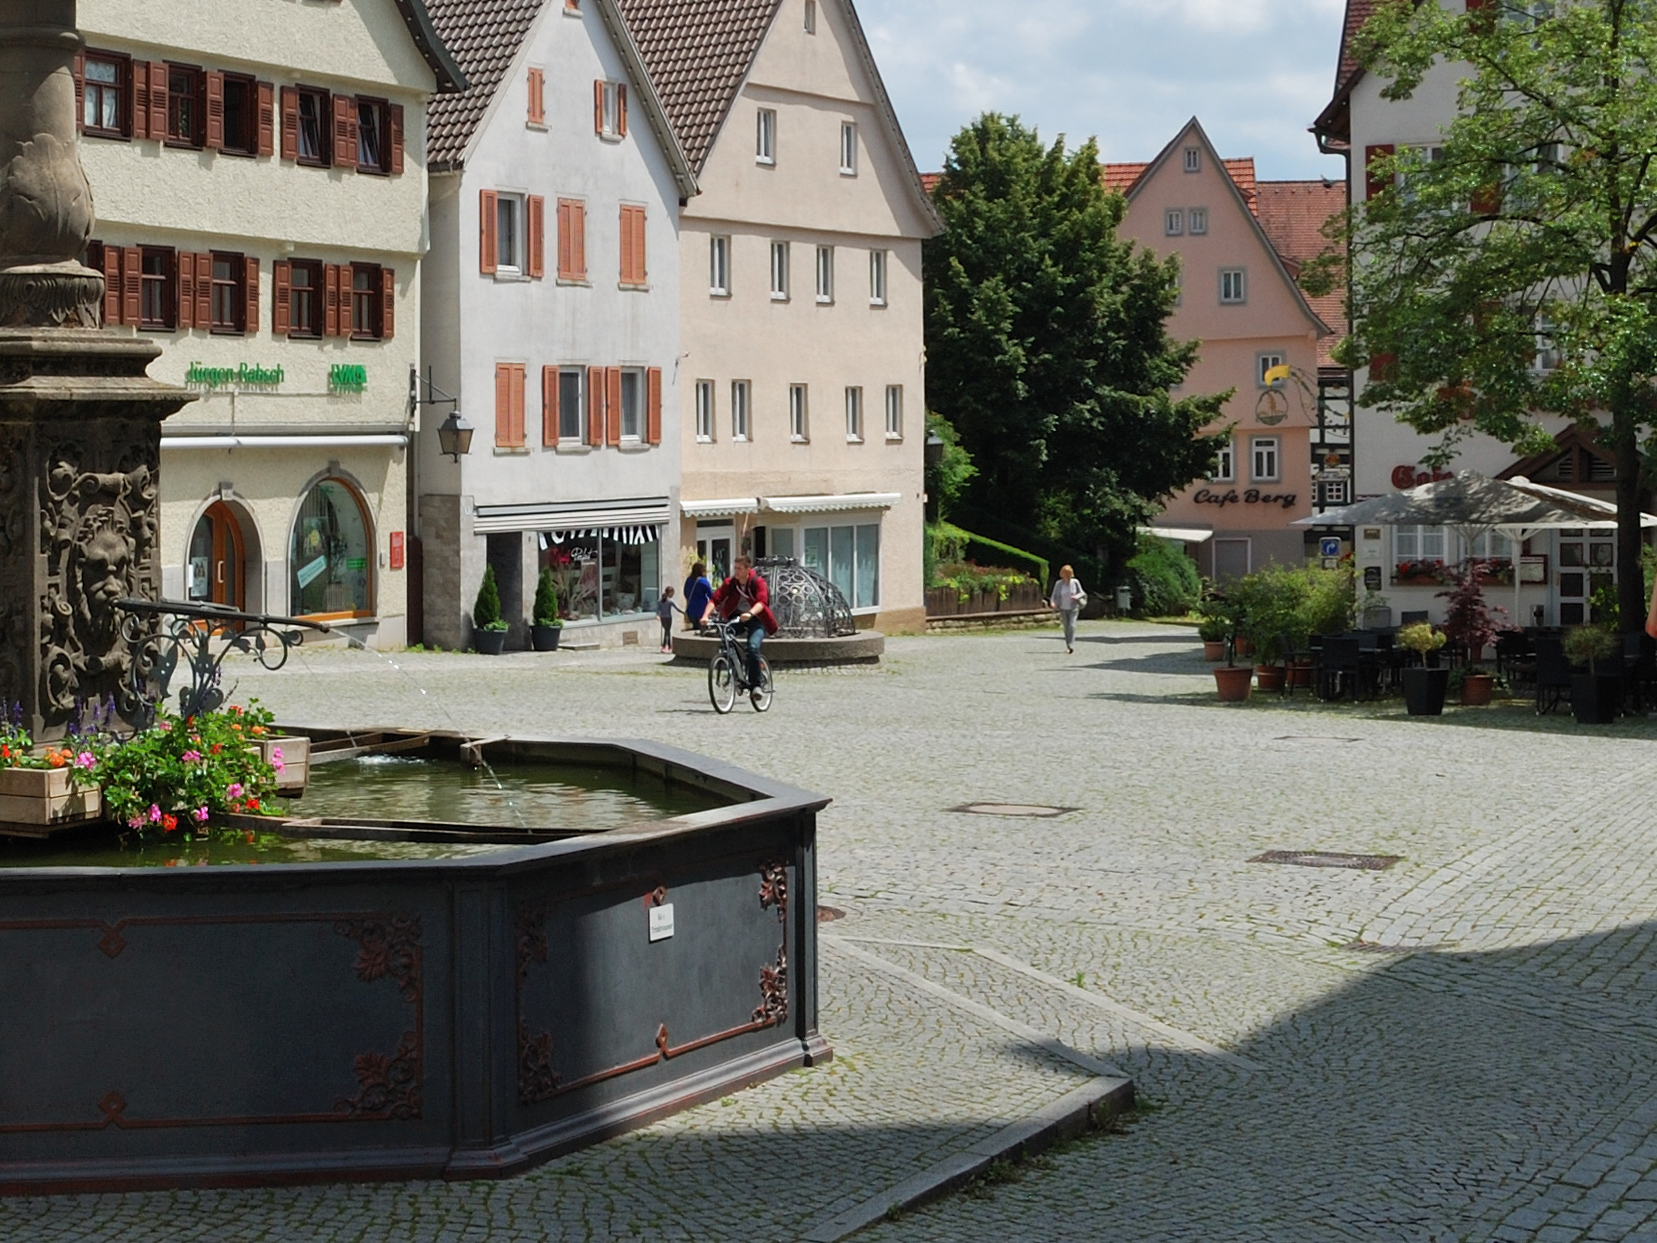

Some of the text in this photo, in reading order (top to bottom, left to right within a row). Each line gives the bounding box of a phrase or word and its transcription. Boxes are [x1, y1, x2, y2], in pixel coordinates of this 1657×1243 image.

[186, 361, 235, 388] Jürgen
[1193, 489, 1297, 509] Cafe Berg
